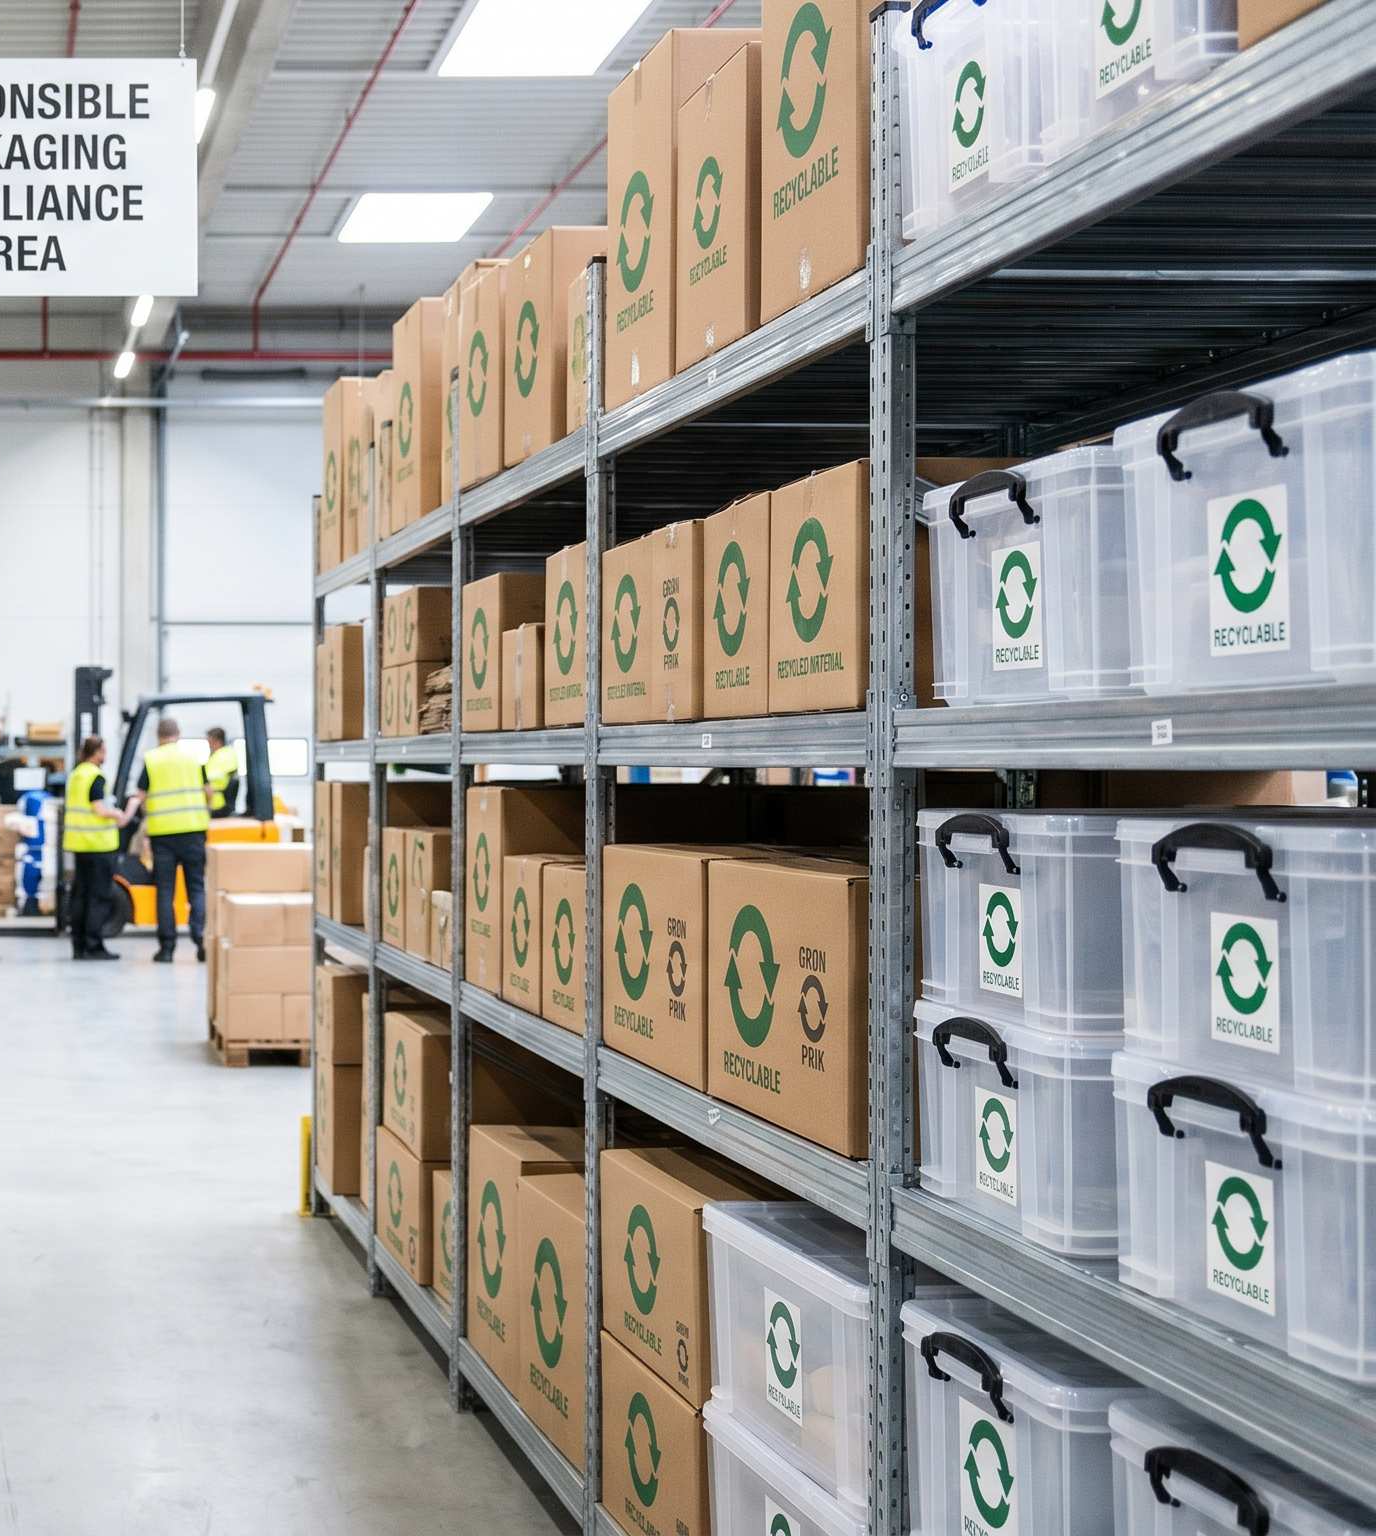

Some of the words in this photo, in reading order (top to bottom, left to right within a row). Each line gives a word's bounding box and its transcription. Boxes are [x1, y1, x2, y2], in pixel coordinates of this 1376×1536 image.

[1099, 38, 1152, 89] RECYCLABLE
[773, 144, 840, 221] RECYCLABLE
[1214, 621, 1285, 648] RECYCLABLE
[1215, 1016, 1273, 1045] RECYCLABLE
[724, 1050, 781, 1095] RECYCLABLE
[801, 1044, 825, 1073] PRIK
[1213, 1268, 1270, 1305] RECYCLABLE
